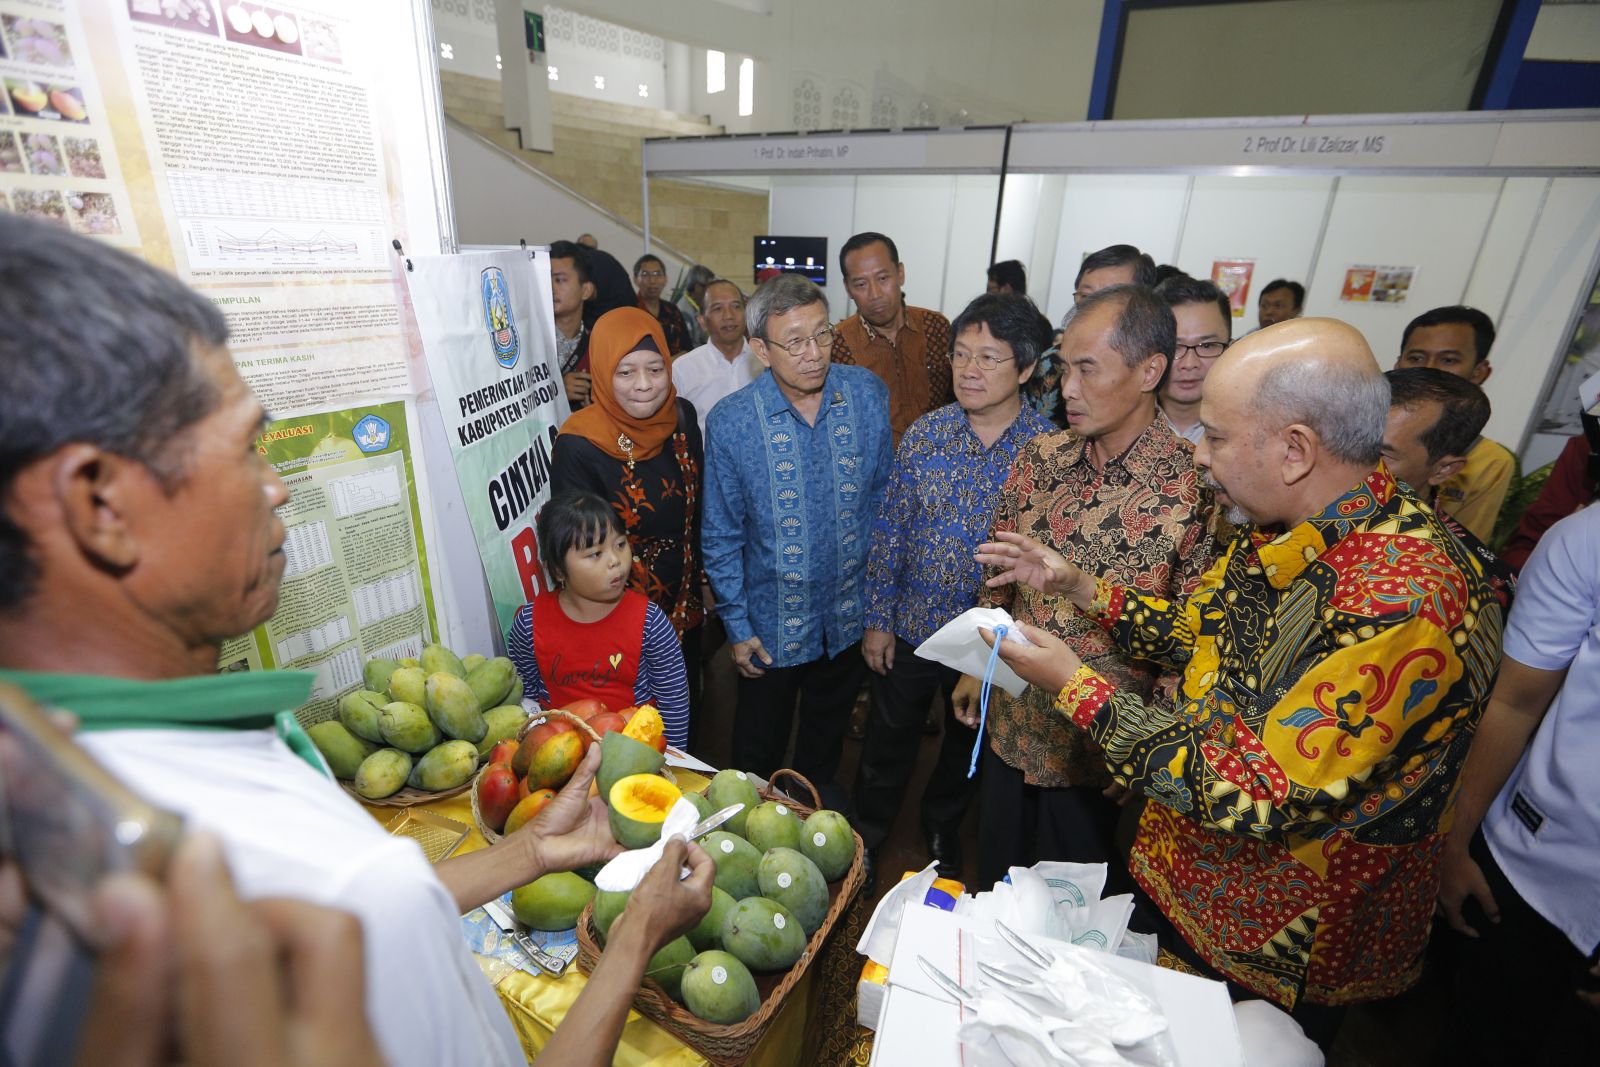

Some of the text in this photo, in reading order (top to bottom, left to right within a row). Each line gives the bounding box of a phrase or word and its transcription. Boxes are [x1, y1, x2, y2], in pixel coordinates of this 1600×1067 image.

[837, 145, 849, 157] MP
[1257, 136, 1280, 153] Prof
[1362, 136, 1385, 152] MS
[208, 296, 261, 305] SIMPULAN
[256, 357, 288, 365] TERIMA
[289, 353, 315, 362] KASIH
[459, 374, 526, 418] PEMERINTAH
[457, 402, 522, 447] KABUPATEN
[261, 425, 314, 442] EVALUASI
